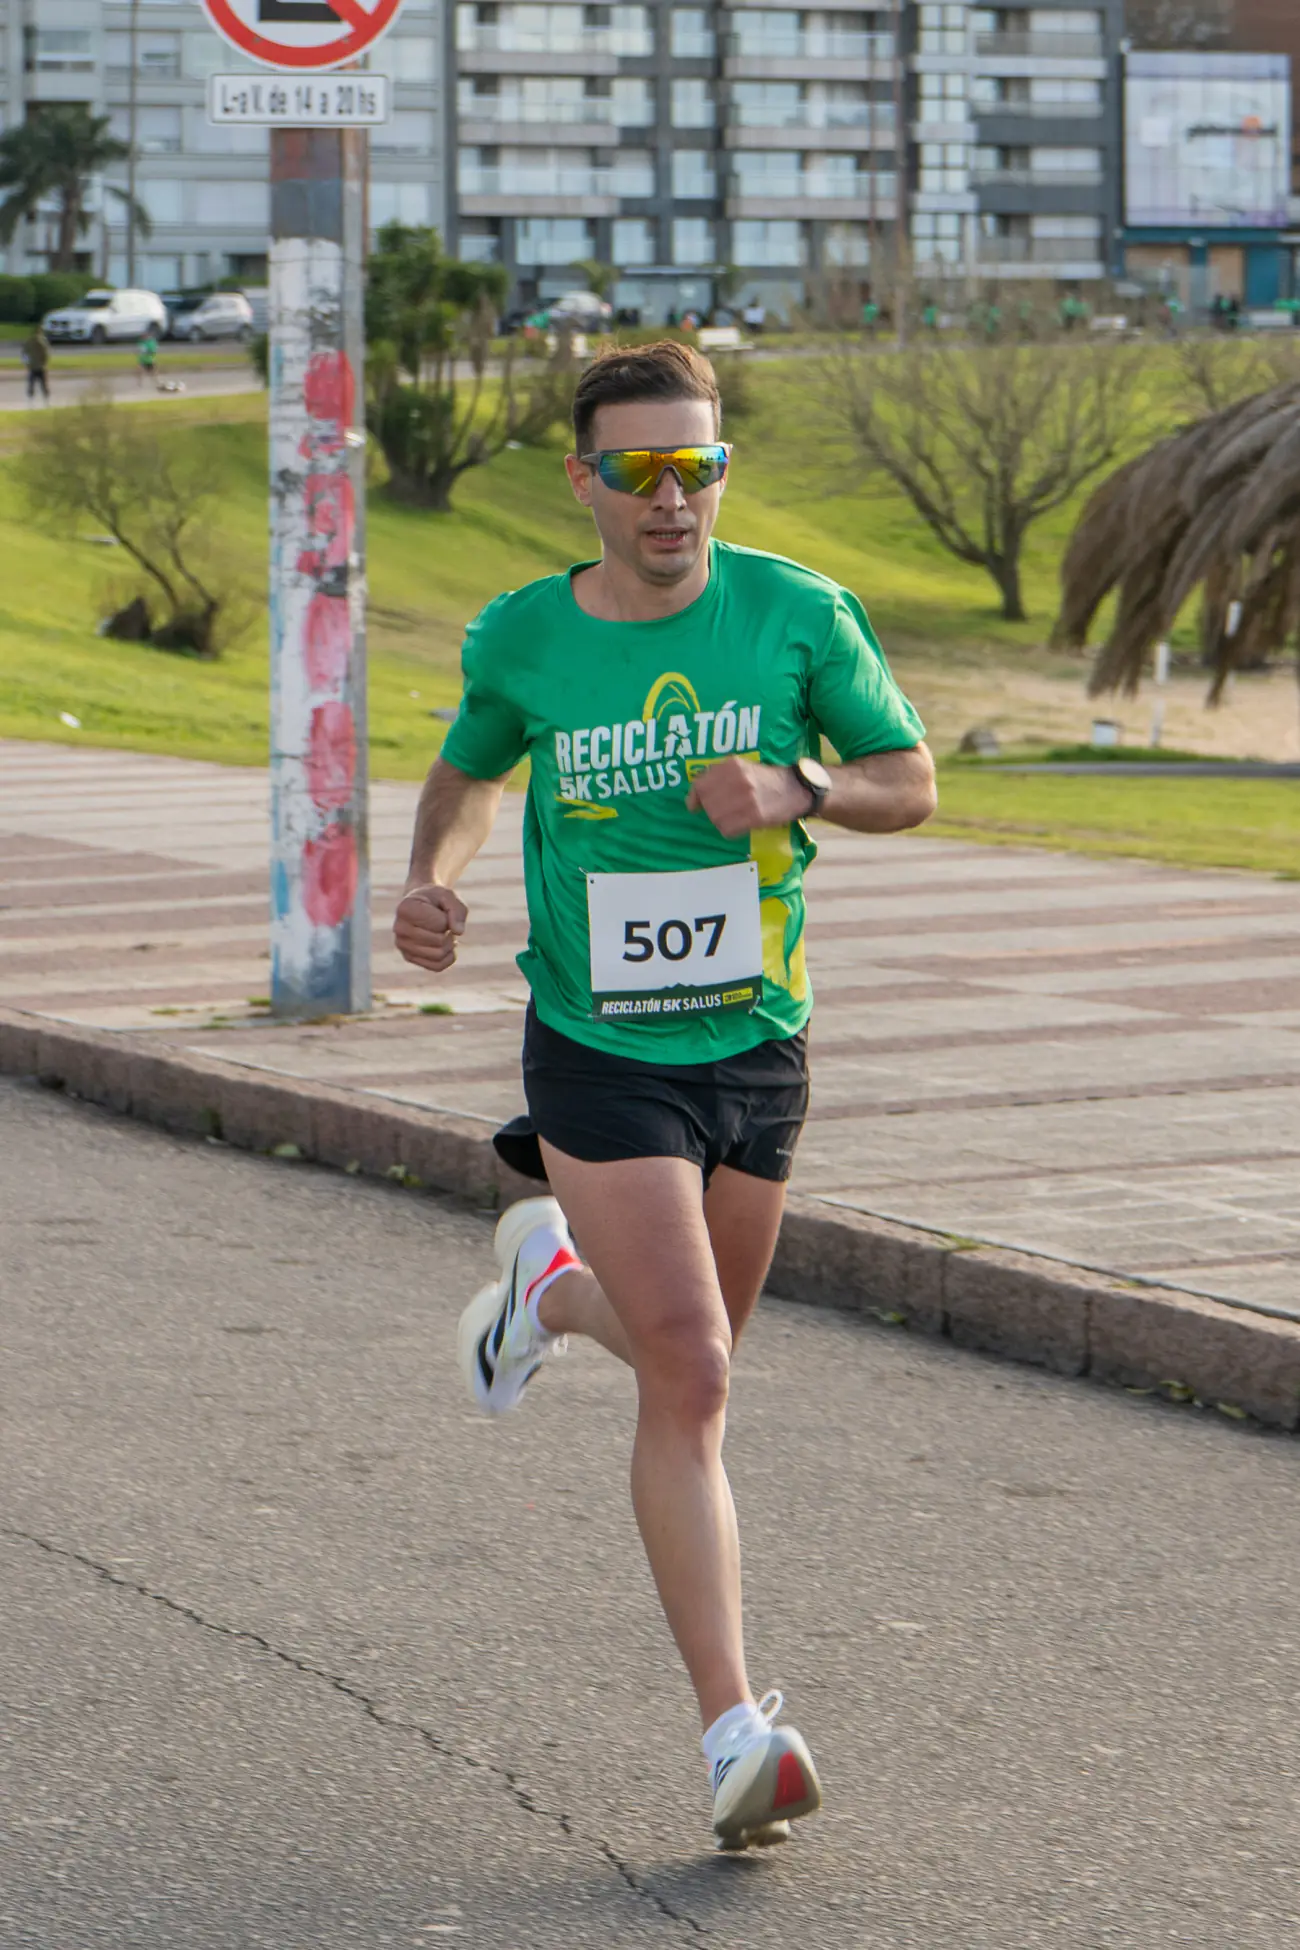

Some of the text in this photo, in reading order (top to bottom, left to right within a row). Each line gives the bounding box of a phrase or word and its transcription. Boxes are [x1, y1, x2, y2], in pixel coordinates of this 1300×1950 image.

[269, 84, 288, 115] de
[295, 84, 314, 115] 14
[320, 92, 329, 115] a
[337, 84, 354, 115] 20
[358, 84, 376, 115] hs
[555, 700, 762, 774] RECICLATÓN
[559, 775, 592, 801] 5K
[595, 759, 682, 800] SALUS
[622, 914, 726, 962] 507
[601, 997, 661, 1015] RECICLATÓN
[662, 1000, 682, 1012] 5K
[683, 994, 721, 1010] SALUS
